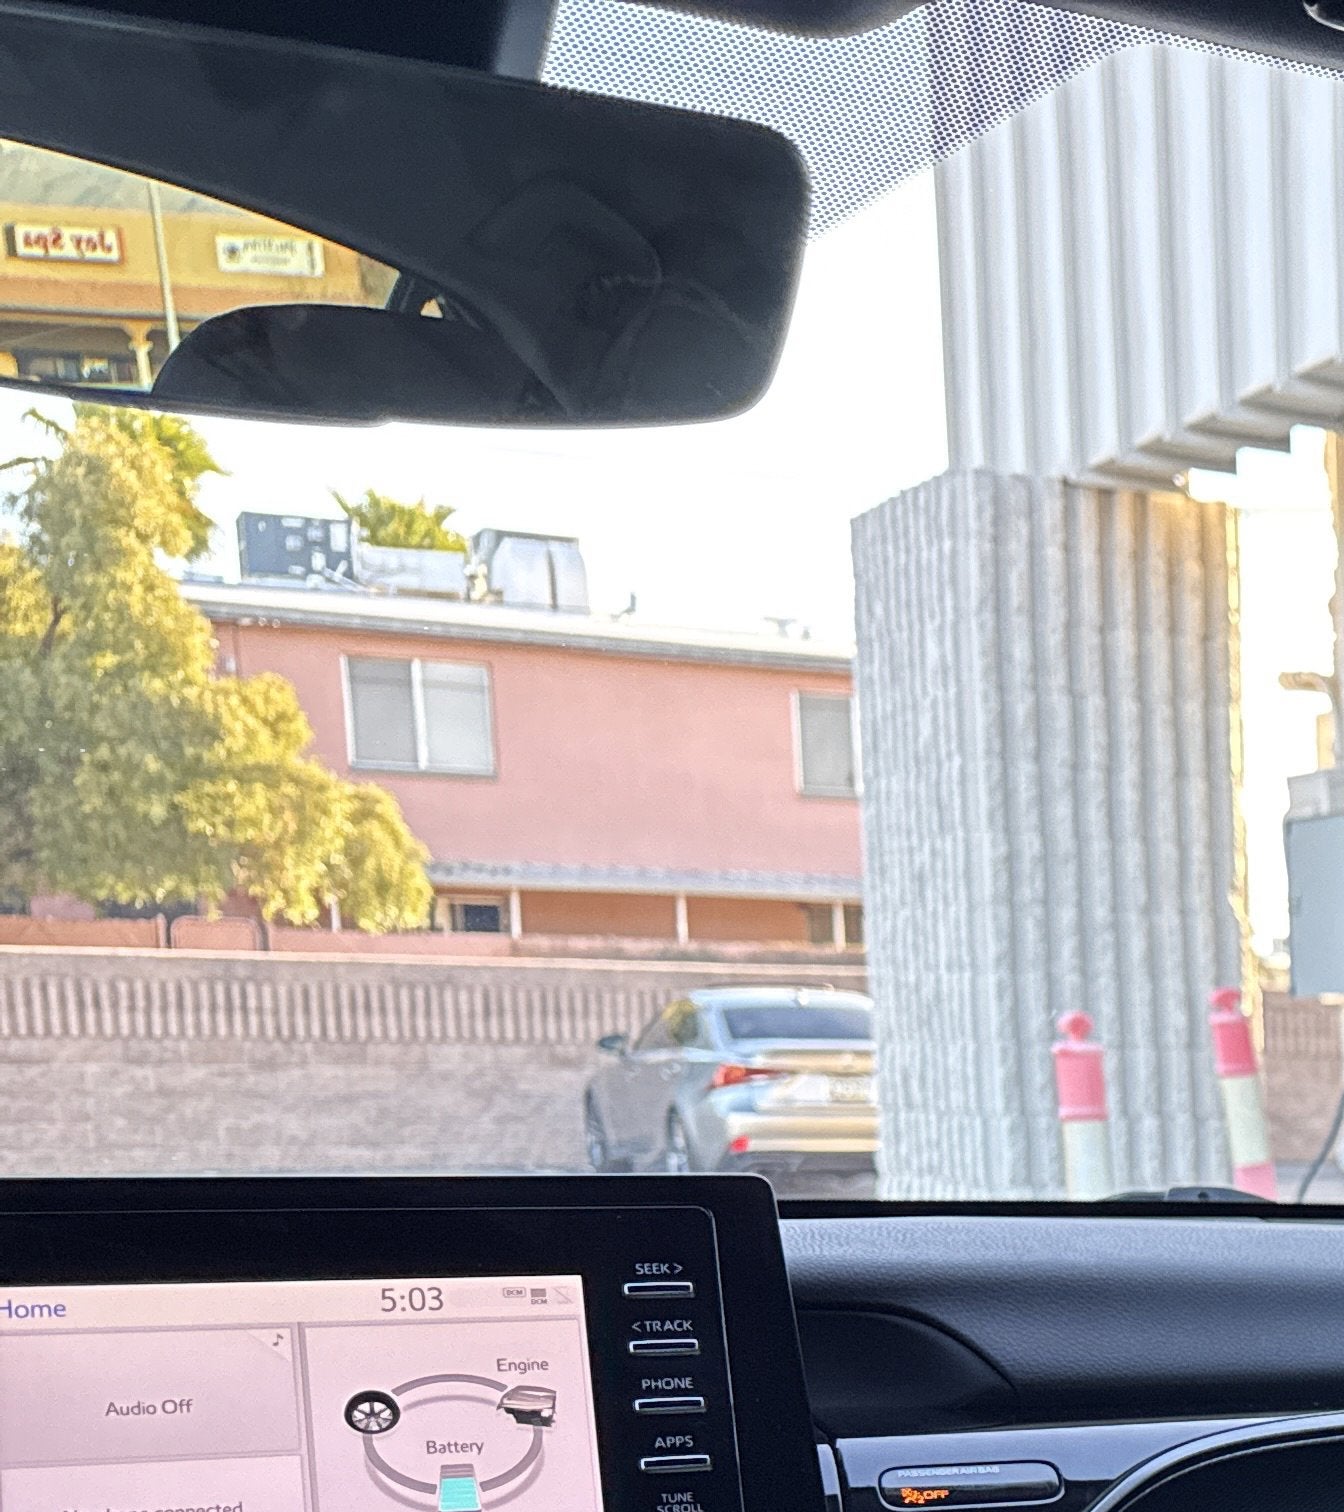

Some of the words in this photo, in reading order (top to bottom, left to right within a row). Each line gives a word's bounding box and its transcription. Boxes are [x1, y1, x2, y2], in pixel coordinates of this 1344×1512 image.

[635, 1262, 671, 1275] SEEK
[381, 1286, 444, 1312] 5:03
[0, 1299, 67, 1319] Home
[644, 1319, 694, 1332] TRACK
[496, 1357, 549, 1374] Engine
[641, 1377, 695, 1390] PHONE
[105, 1401, 157, 1417] Audio
[161, 1398, 194, 1415] Off
[426, 1440, 484, 1456] Battery
[654, 1435, 694, 1449] APPS
[661, 1491, 694, 1503] TUNE
[923, 1488, 949, 1500] OFF
